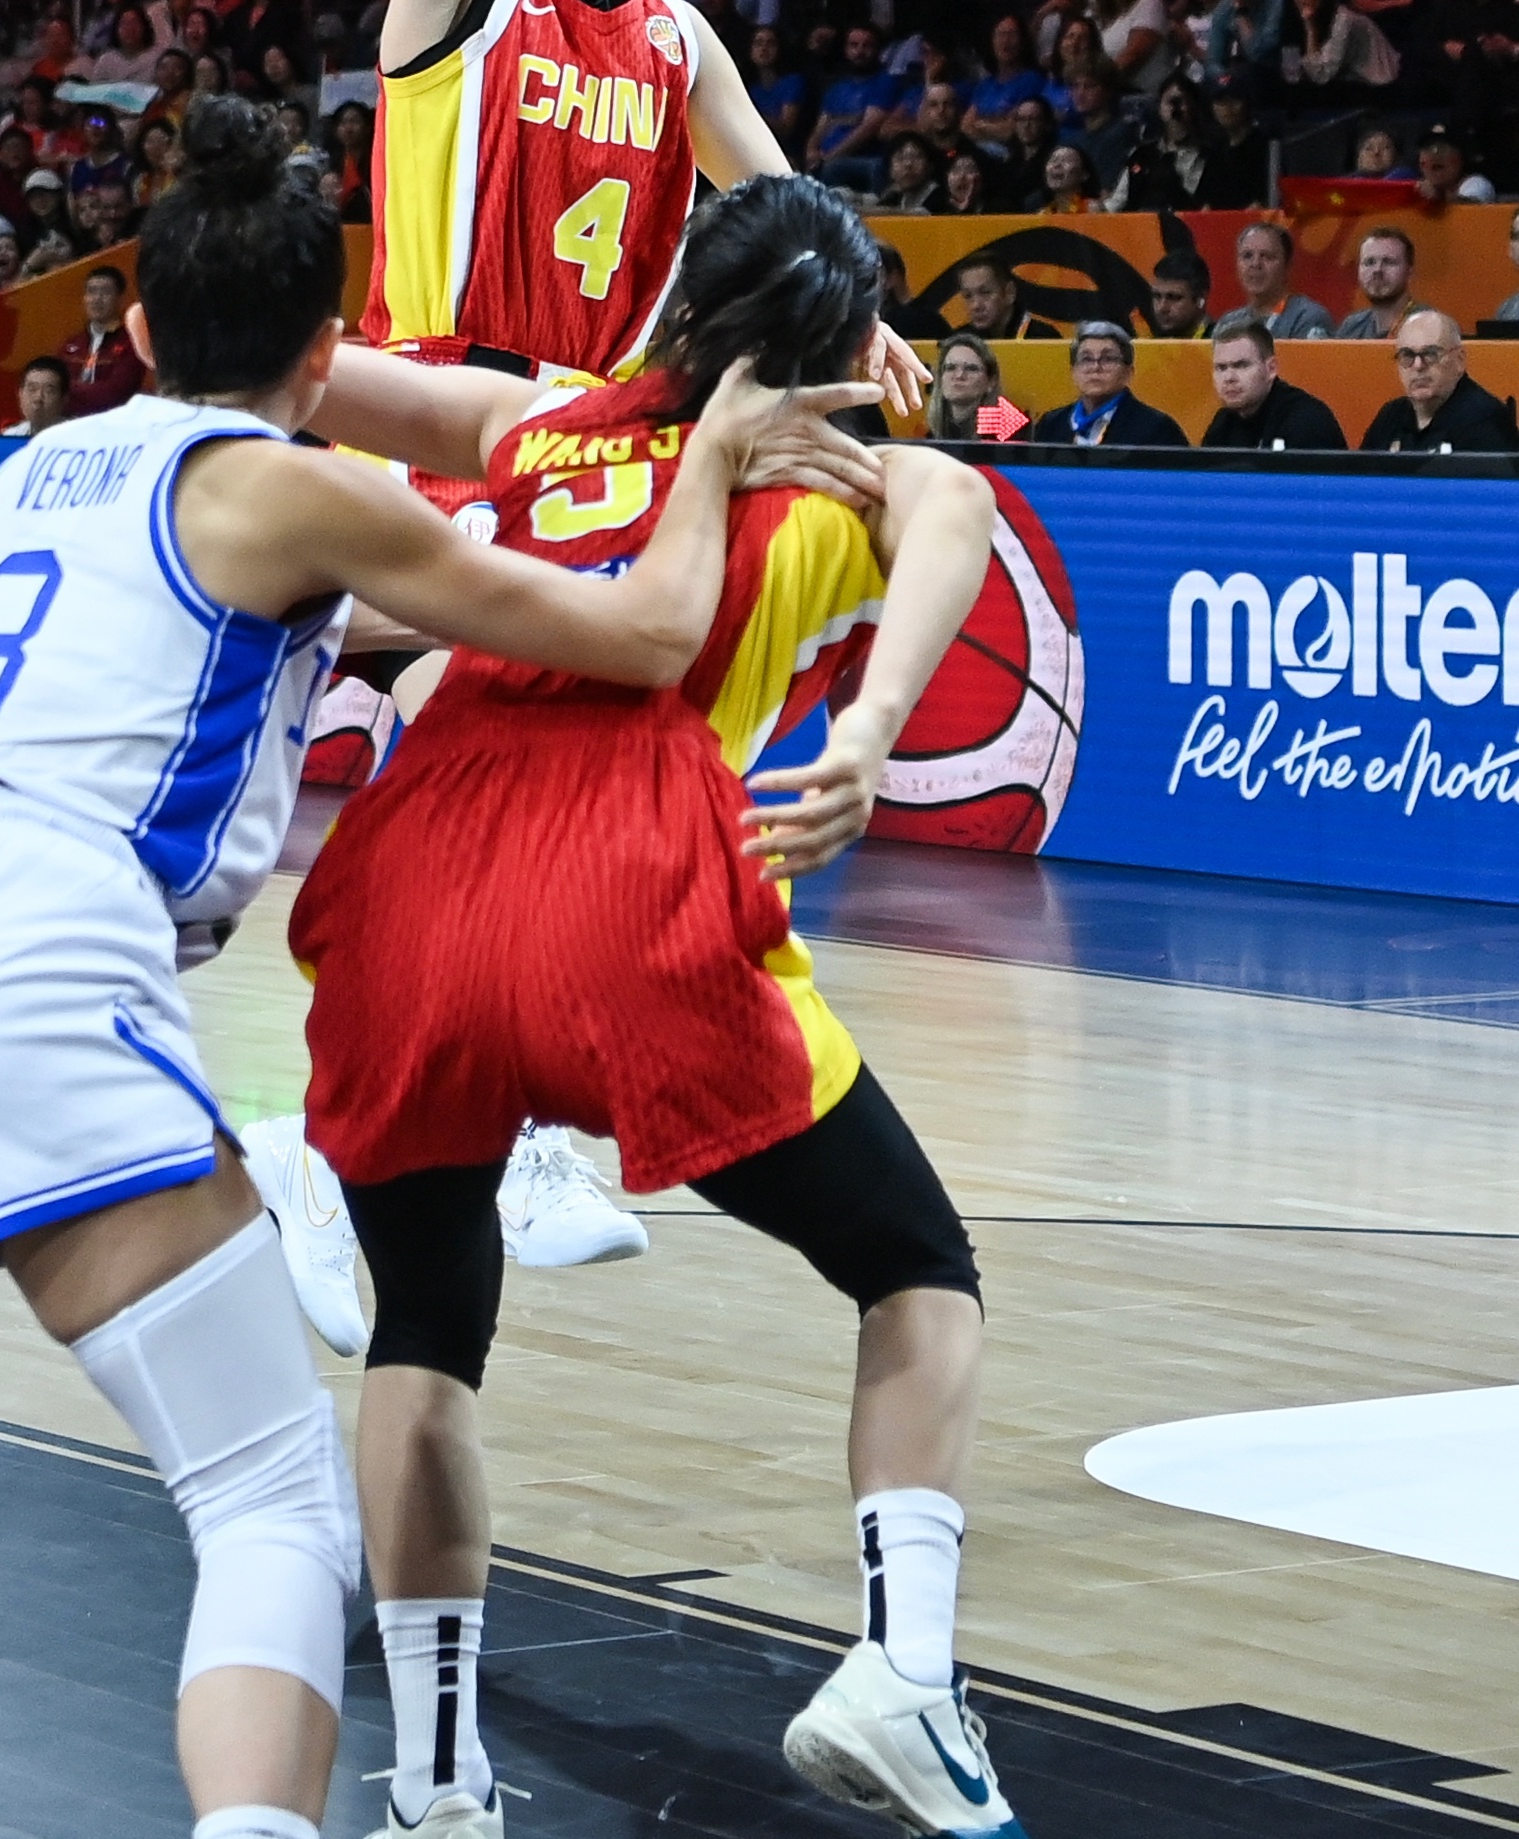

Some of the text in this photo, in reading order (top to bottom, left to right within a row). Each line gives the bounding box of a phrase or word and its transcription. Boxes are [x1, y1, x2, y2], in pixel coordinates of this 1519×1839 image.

[518, 54, 668, 152] CHIN
[554, 178, 630, 300] 4
[16, 444, 144, 510] VERONA
[1168, 552, 1519, 706] molte
[1168, 695, 1279, 801] feel
[1272, 718, 1362, 798] the
